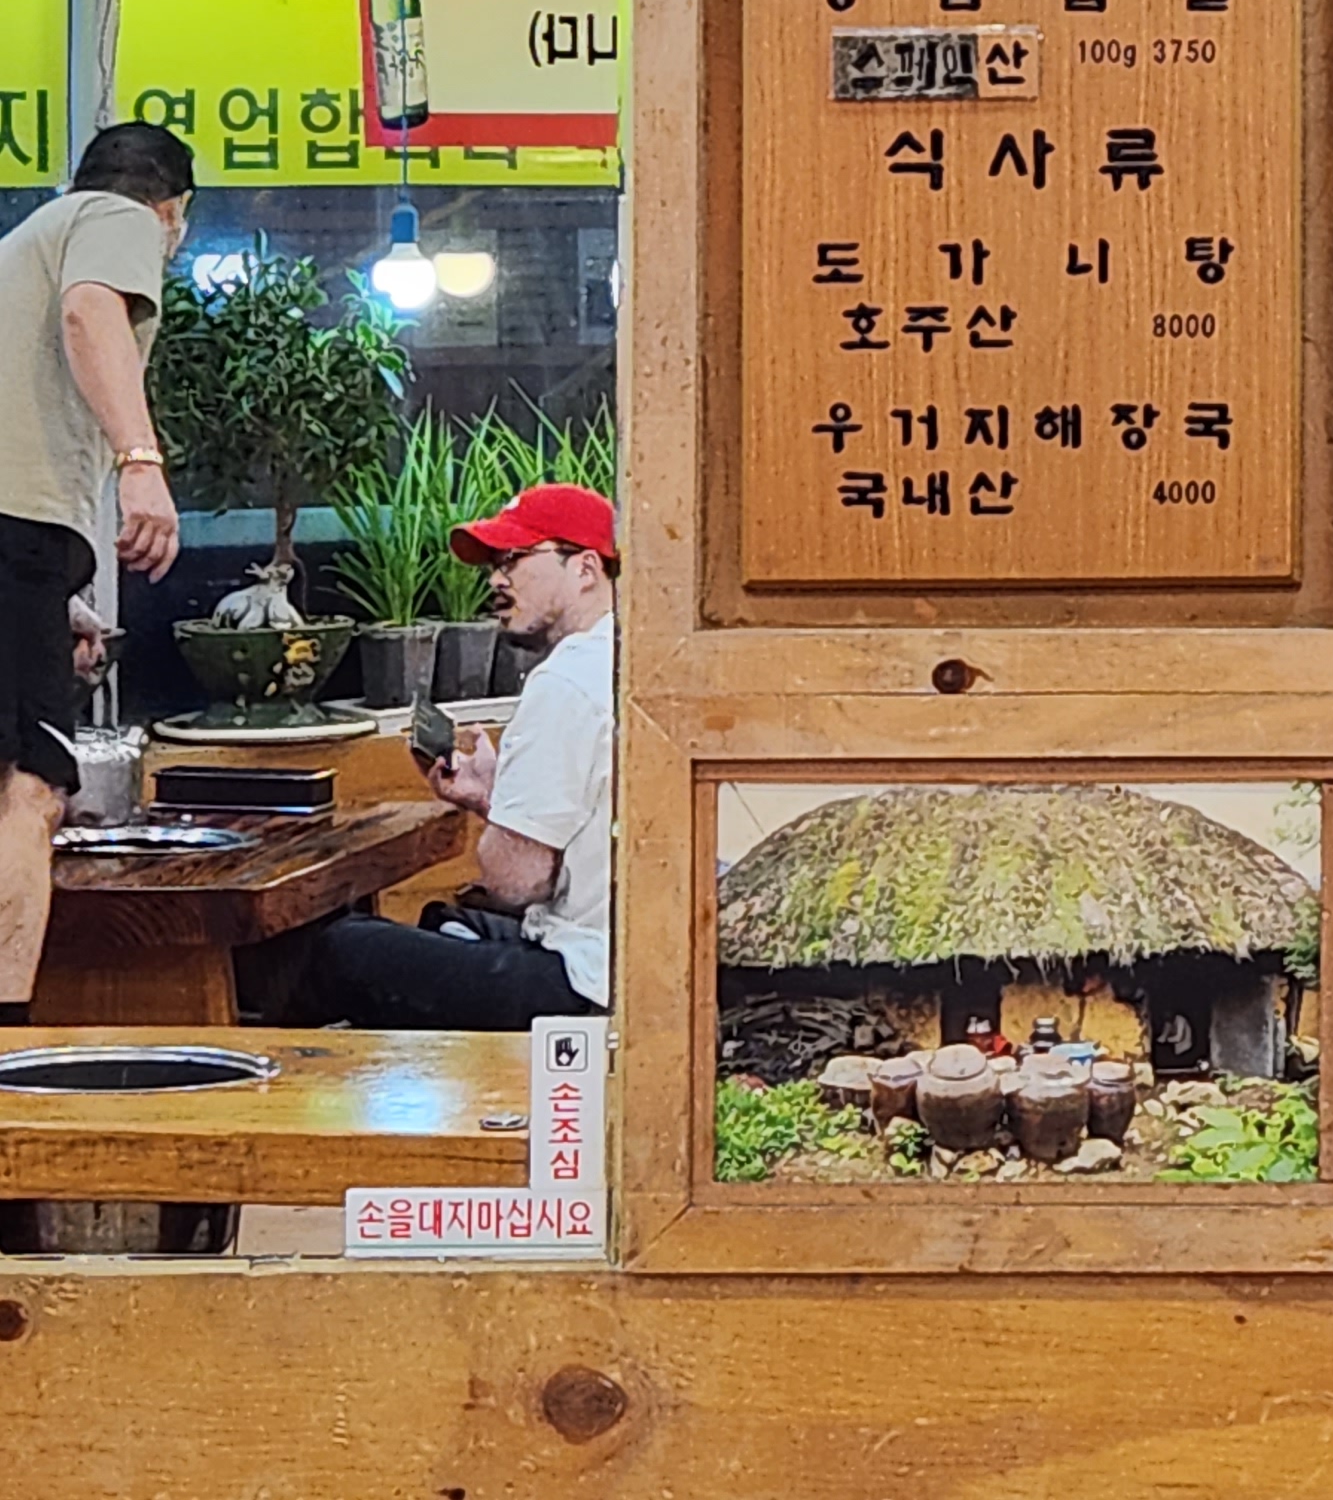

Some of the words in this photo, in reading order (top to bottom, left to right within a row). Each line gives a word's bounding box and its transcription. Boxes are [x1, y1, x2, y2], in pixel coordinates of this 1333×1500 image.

[1078, 38, 1137, 69] 100g
[1153, 38, 1216, 65] 3750
[839, 302, 1018, 353] 호주산
[1152, 313, 1216, 339] 8000
[837, 470, 1019, 519] 국내산
[1152, 480, 1216, 505] 4000
[548, 1082, 584, 1181] 손조심
